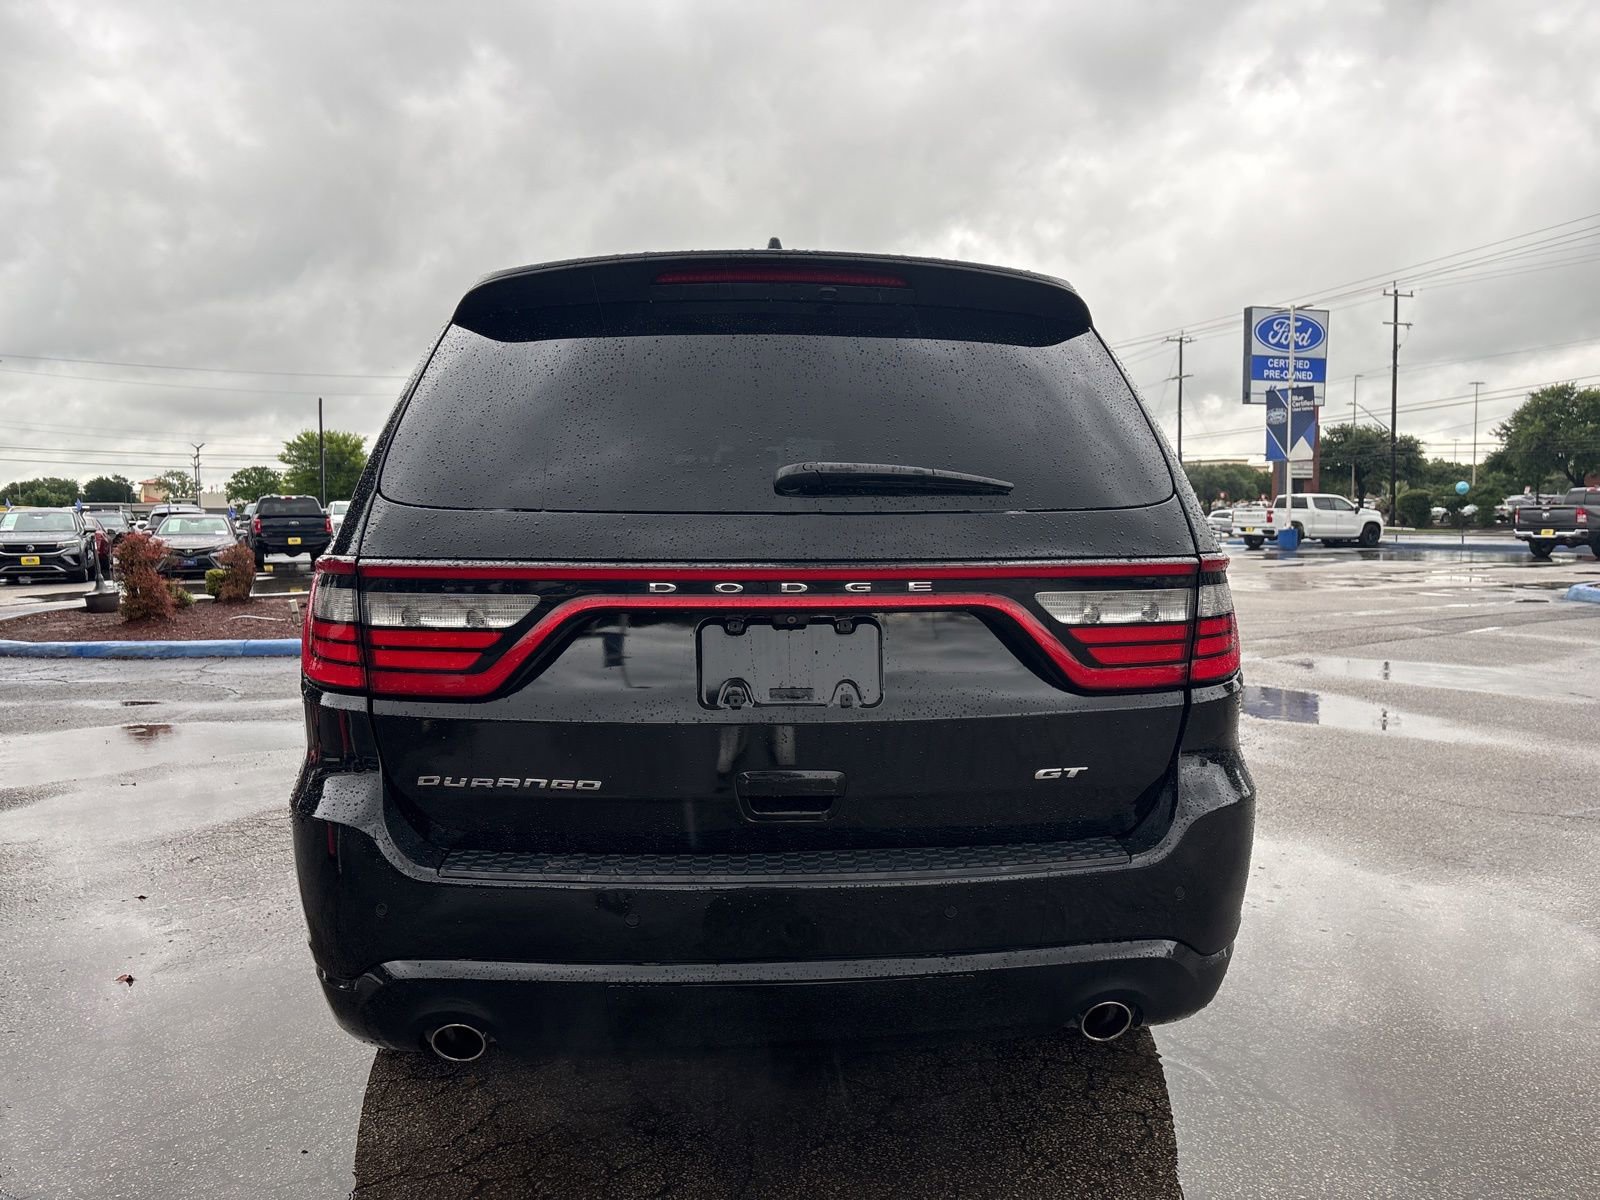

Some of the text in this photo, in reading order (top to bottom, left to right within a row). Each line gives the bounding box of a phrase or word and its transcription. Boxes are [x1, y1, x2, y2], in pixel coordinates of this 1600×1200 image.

[1268, 359, 1310, 369] CERTFIED
[648, 581, 933, 593] DODGE
[1034, 766, 1089, 780] GT
[416, 775, 602, 791] DURANGO
